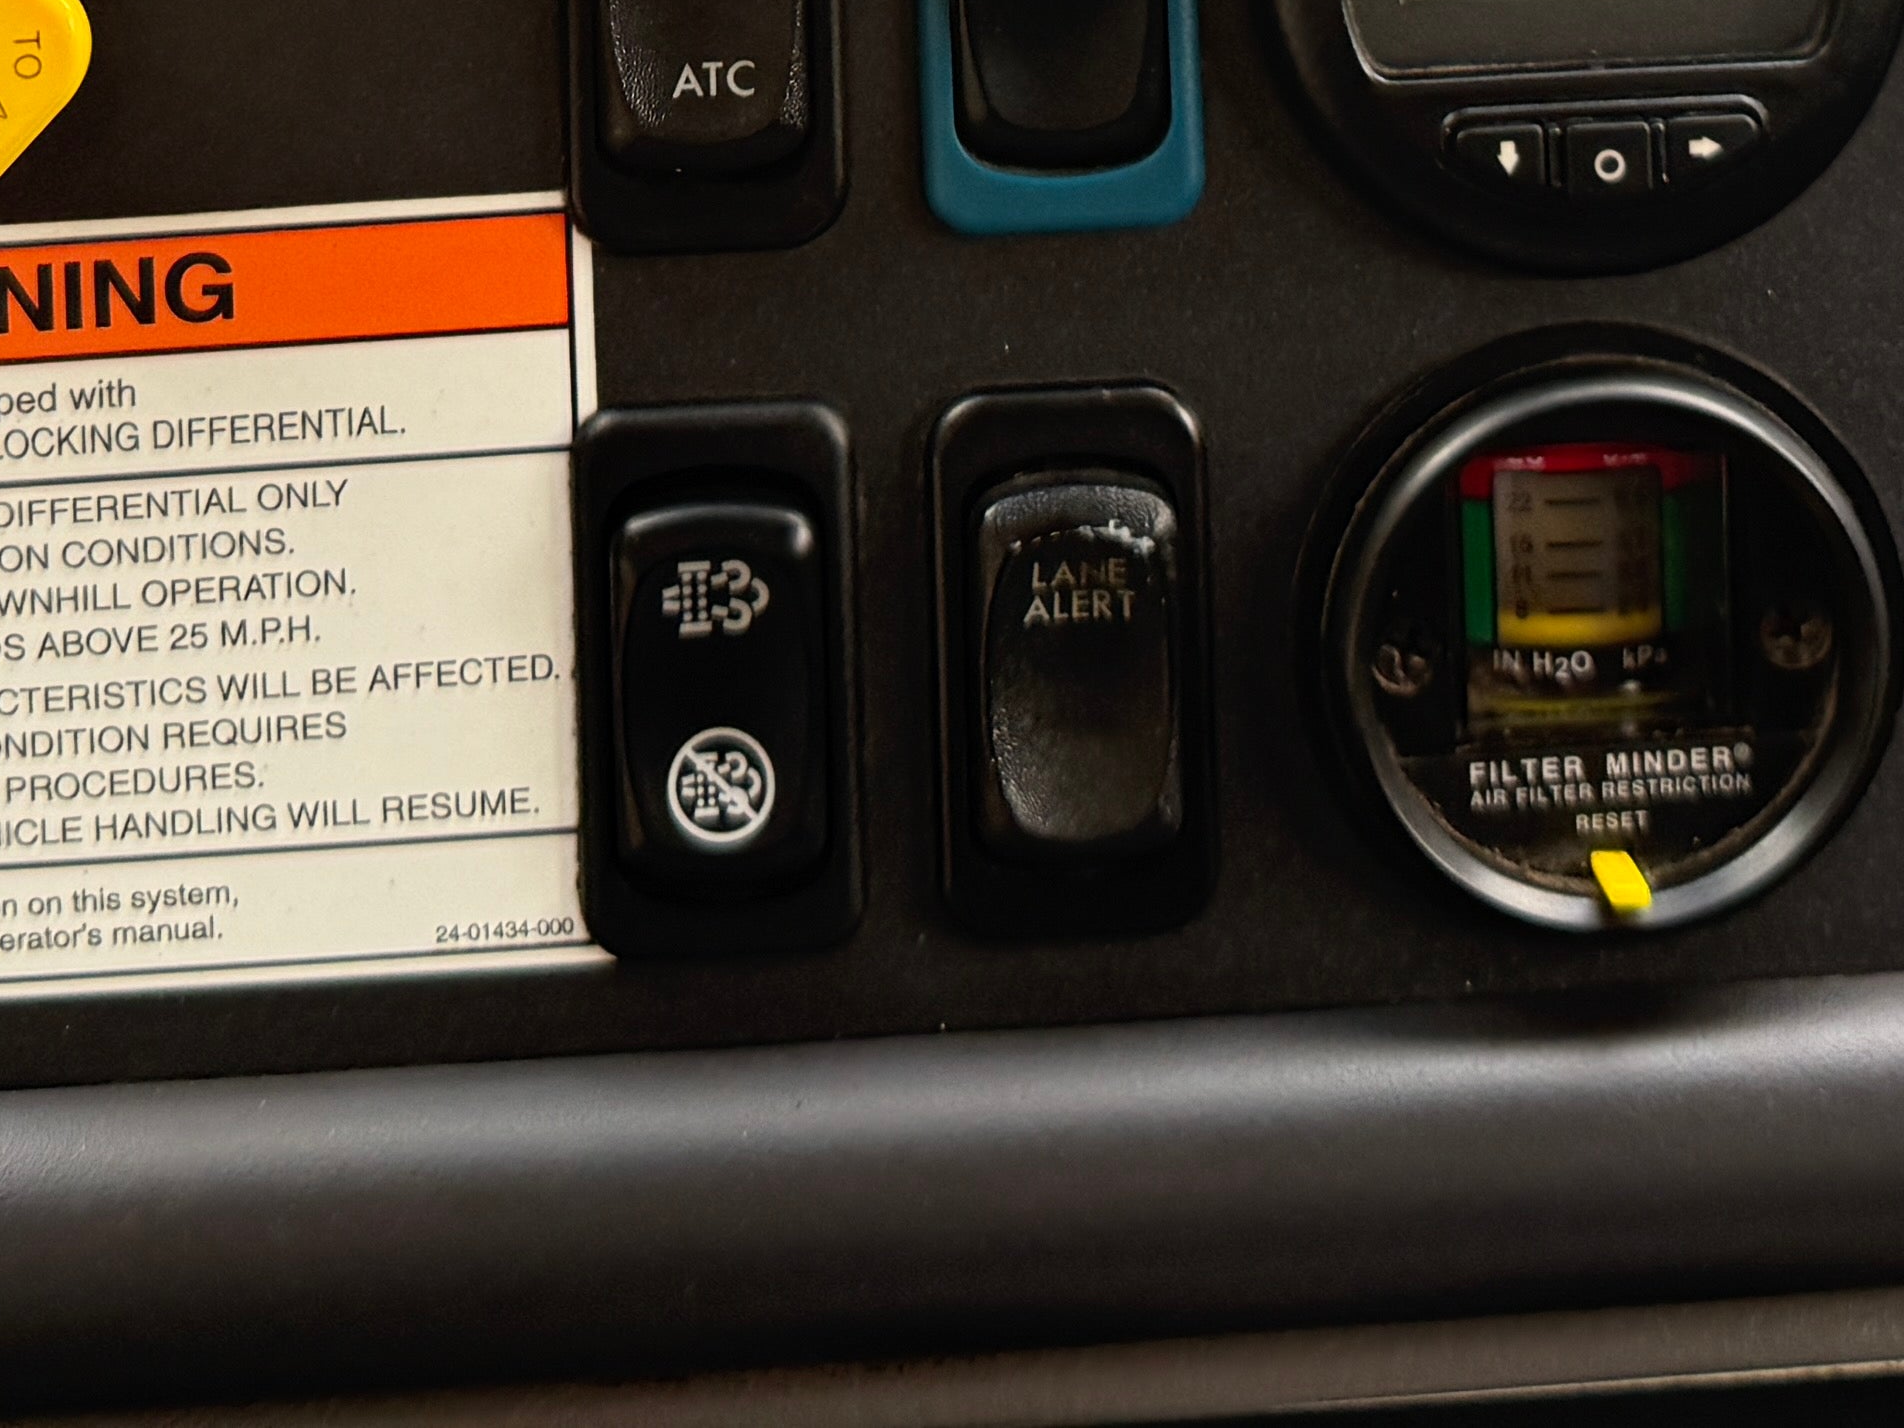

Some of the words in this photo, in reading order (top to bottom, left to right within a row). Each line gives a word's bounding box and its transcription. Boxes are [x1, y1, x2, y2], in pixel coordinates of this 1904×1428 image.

[12, 30, 42, 81] TO
[672, 61, 756, 99] ATC
[69, 379, 136, 410] with
[153, 405, 405, 449] DIFFERENTIAL.
[257, 479, 348, 511] ONLY
[61, 528, 294, 569] CONDITIONS.
[141, 568, 356, 607] OPERATION.
[1031, 555, 1126, 590] LANE
[1023, 588, 1135, 628] ALERT
[37, 625, 158, 660] ABOVE
[170, 623, 208, 651] 25
[221, 615, 320, 647] M.P.H.
[217, 671, 300, 702] WILL
[312, 666, 357, 696] BE
[368, 654, 559, 693] AFFECTED.
[163, 711, 347, 750] REQUIRES
[6, 761, 264, 804] PROCEDURES.
[1469, 755, 1585, 787] FILTER
[1470, 788, 1507, 811] AIR
[1516, 783, 1594, 810] FILTER
[1602, 773, 1751, 801] RESTRICTION
[95, 804, 276, 842] HANDLING
[287, 799, 370, 829] WILL
[382, 787, 539, 823] RESUME.
[1575, 810, 1648, 834] RESET
[28, 896, 61, 916] on
[72, 888, 120, 913] this
[131, 884, 238, 914] system,
[113, 915, 223, 945] manual.
[436, 917, 574, 943] 24-01434-000
